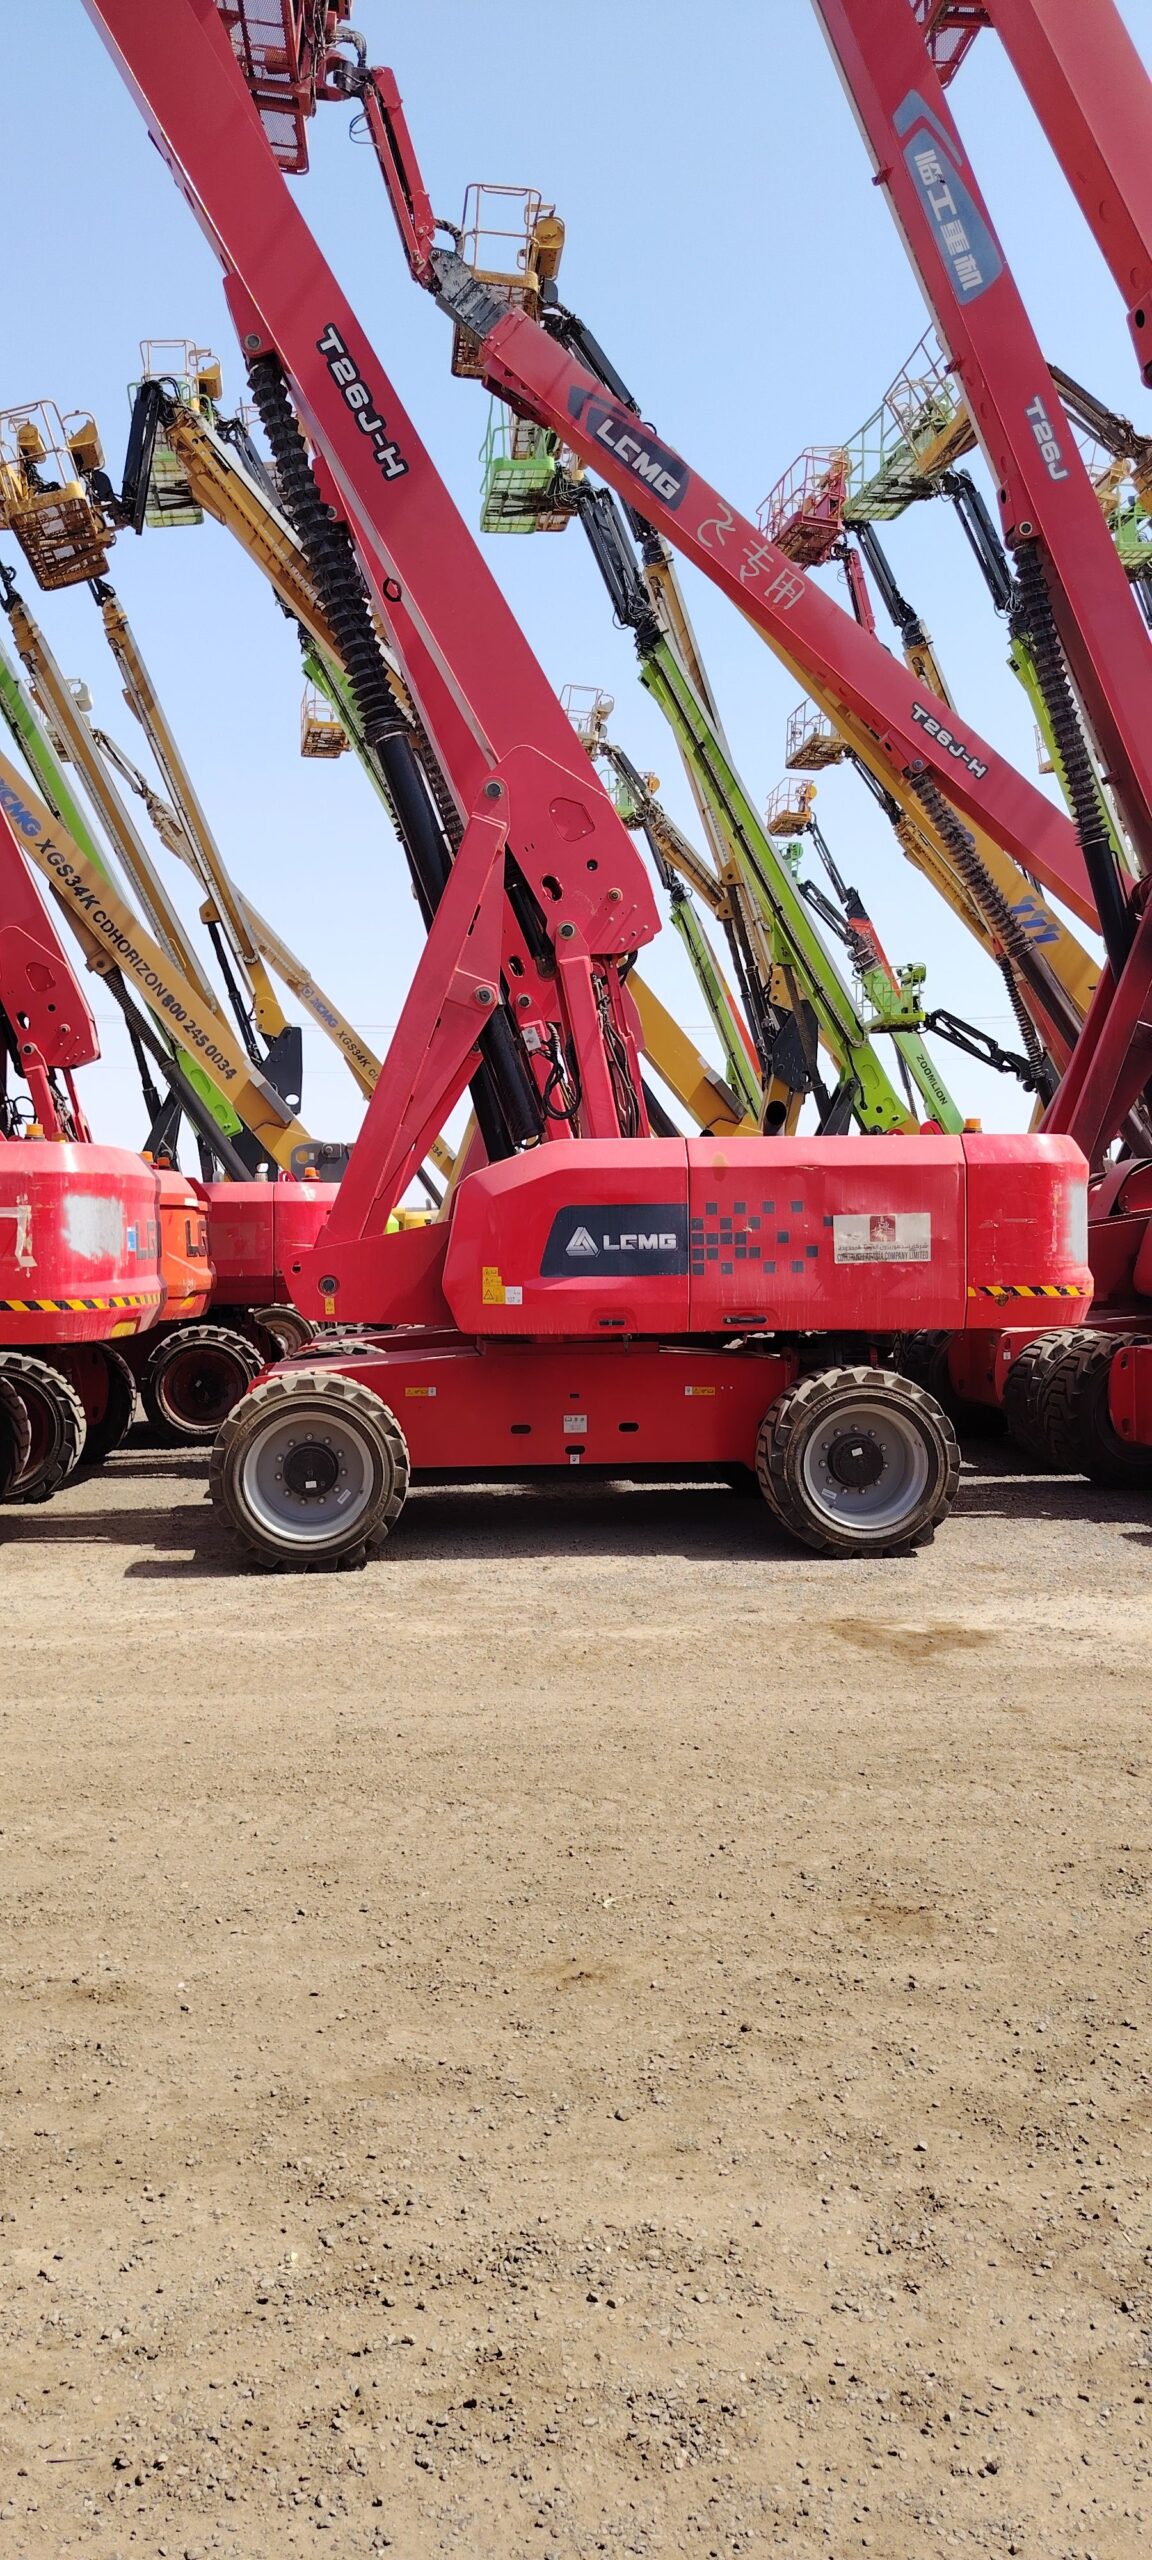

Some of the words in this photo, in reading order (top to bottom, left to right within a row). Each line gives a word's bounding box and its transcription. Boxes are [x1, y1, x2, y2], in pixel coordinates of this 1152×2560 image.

[914, 150, 983, 291] 临工重机
[317, 324, 408, 480] T26J-H
[1025, 395, 1069, 481] T26J
[911, 702, 988, 779] T26J-H
[35, 838, 101, 911] XGS34K
[92, 910, 168, 998] CDHORIZON
[161, 994, 188, 1022] 800
[183, 1019, 210, 1048] 245
[204, 1044, 238, 1080] 0034
[336, 1030, 371, 1067] XGS34K
[916, 1053, 948, 1106] ZOOMLION
[885, 1251, 908, 1260] COMPANY
[909, 1250, 929, 1260] LIMITED
